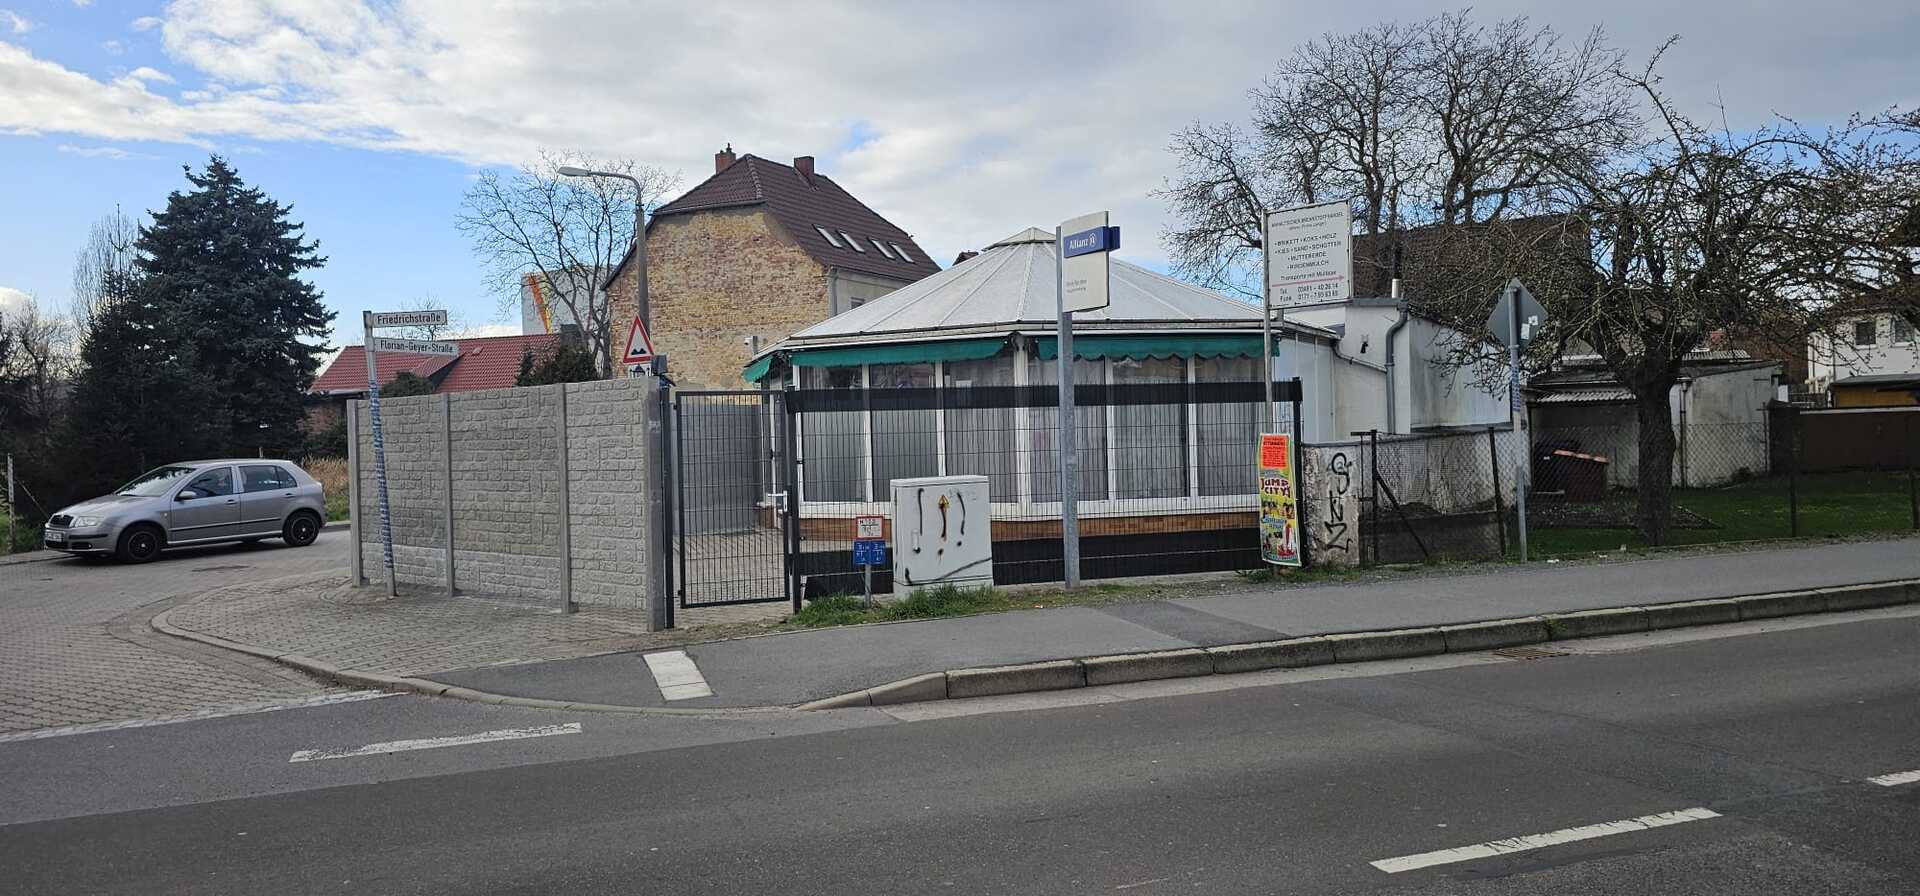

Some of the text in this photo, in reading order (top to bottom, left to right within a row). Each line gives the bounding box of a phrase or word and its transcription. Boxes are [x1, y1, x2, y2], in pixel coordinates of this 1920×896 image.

[1069, 239, 1088, 250] Allianz
[377, 313, 441, 324] Friedrichstraße
[380, 340, 453, 353] Florian-Geyer-Straße
